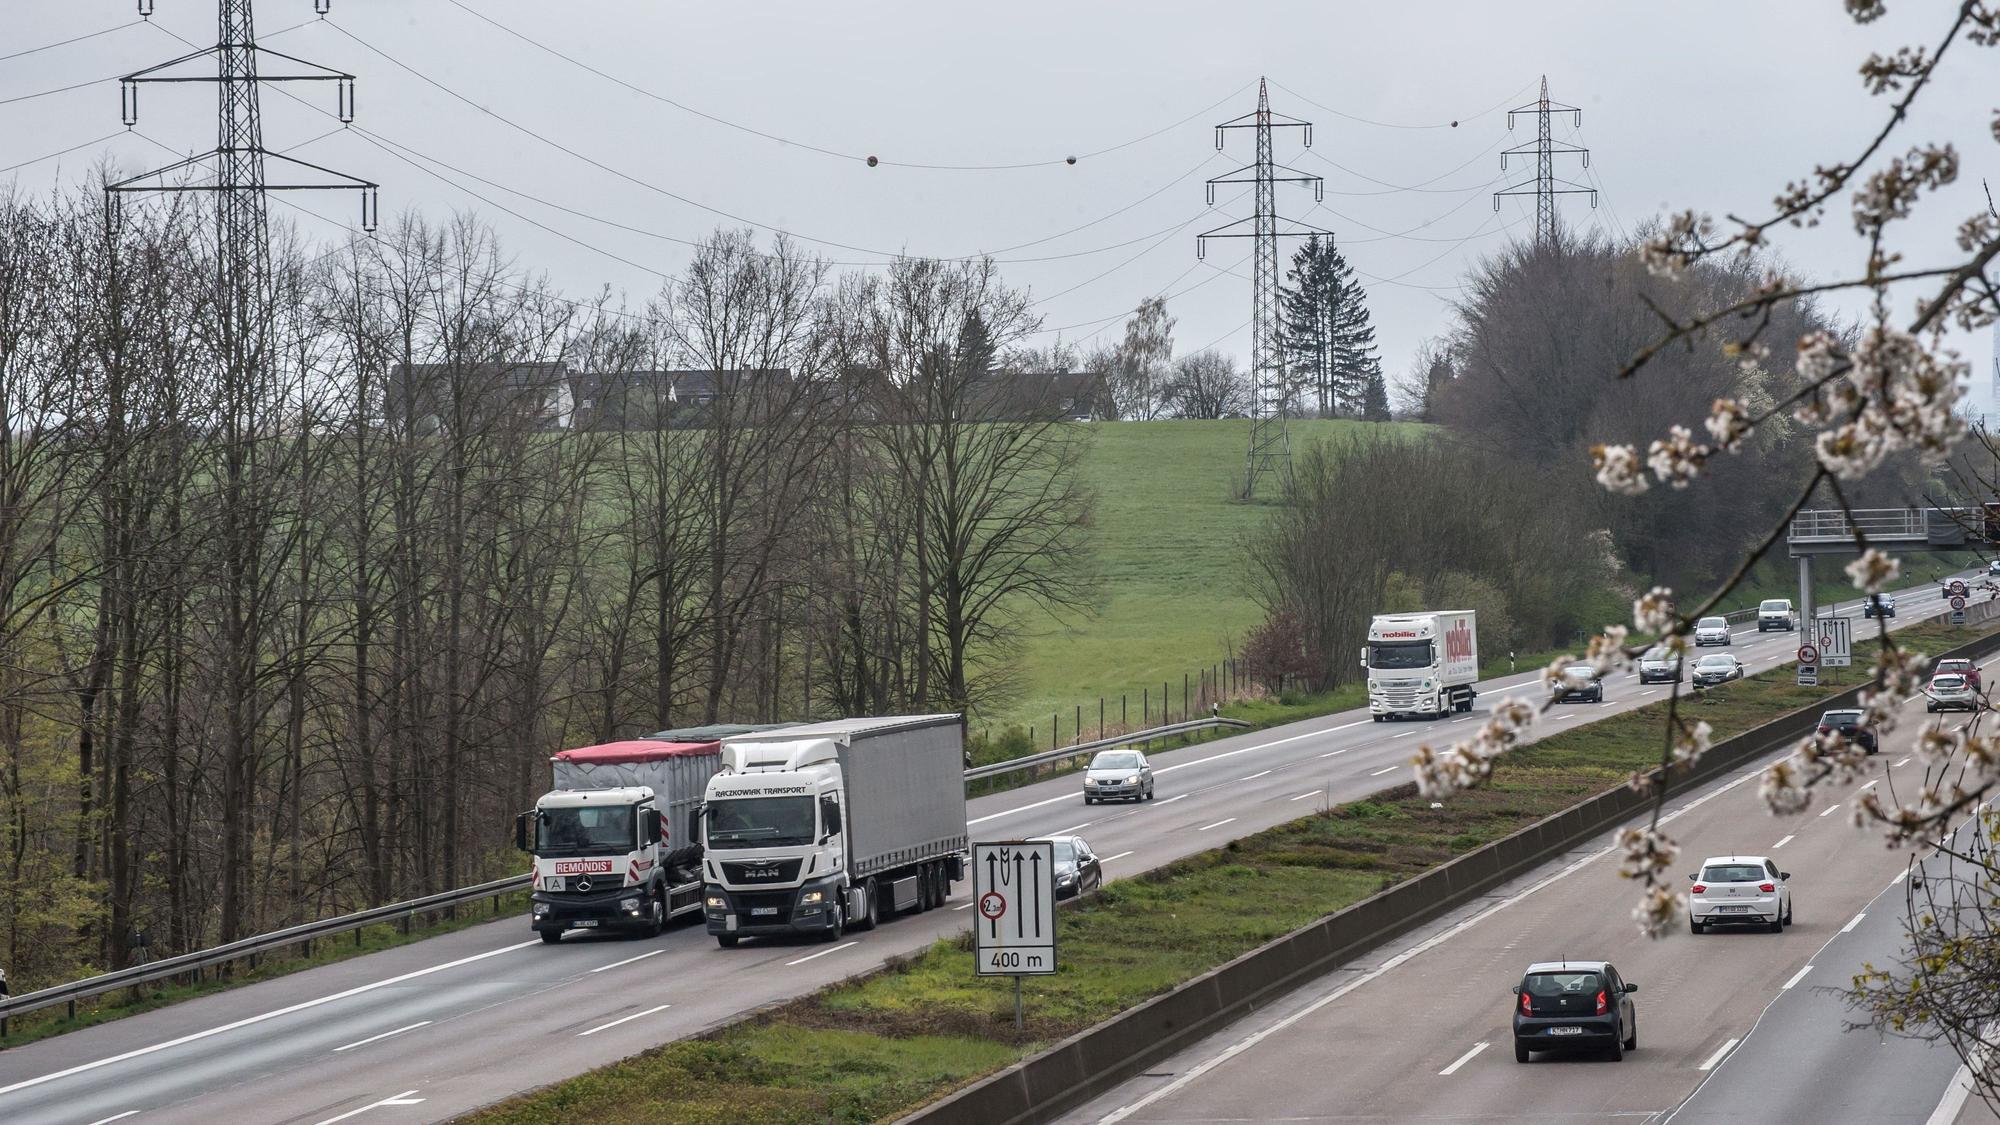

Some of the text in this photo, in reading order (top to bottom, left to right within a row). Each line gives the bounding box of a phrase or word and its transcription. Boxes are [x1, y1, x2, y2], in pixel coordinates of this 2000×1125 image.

[715, 786, 806, 798] RACZKOWIAK TRANSPORT
[557, 862, 607, 873] REMONDIS
[744, 869, 779, 878] MAN
[551, 880, 561, 890] A
[991, 952, 1042, 967] 400 m
